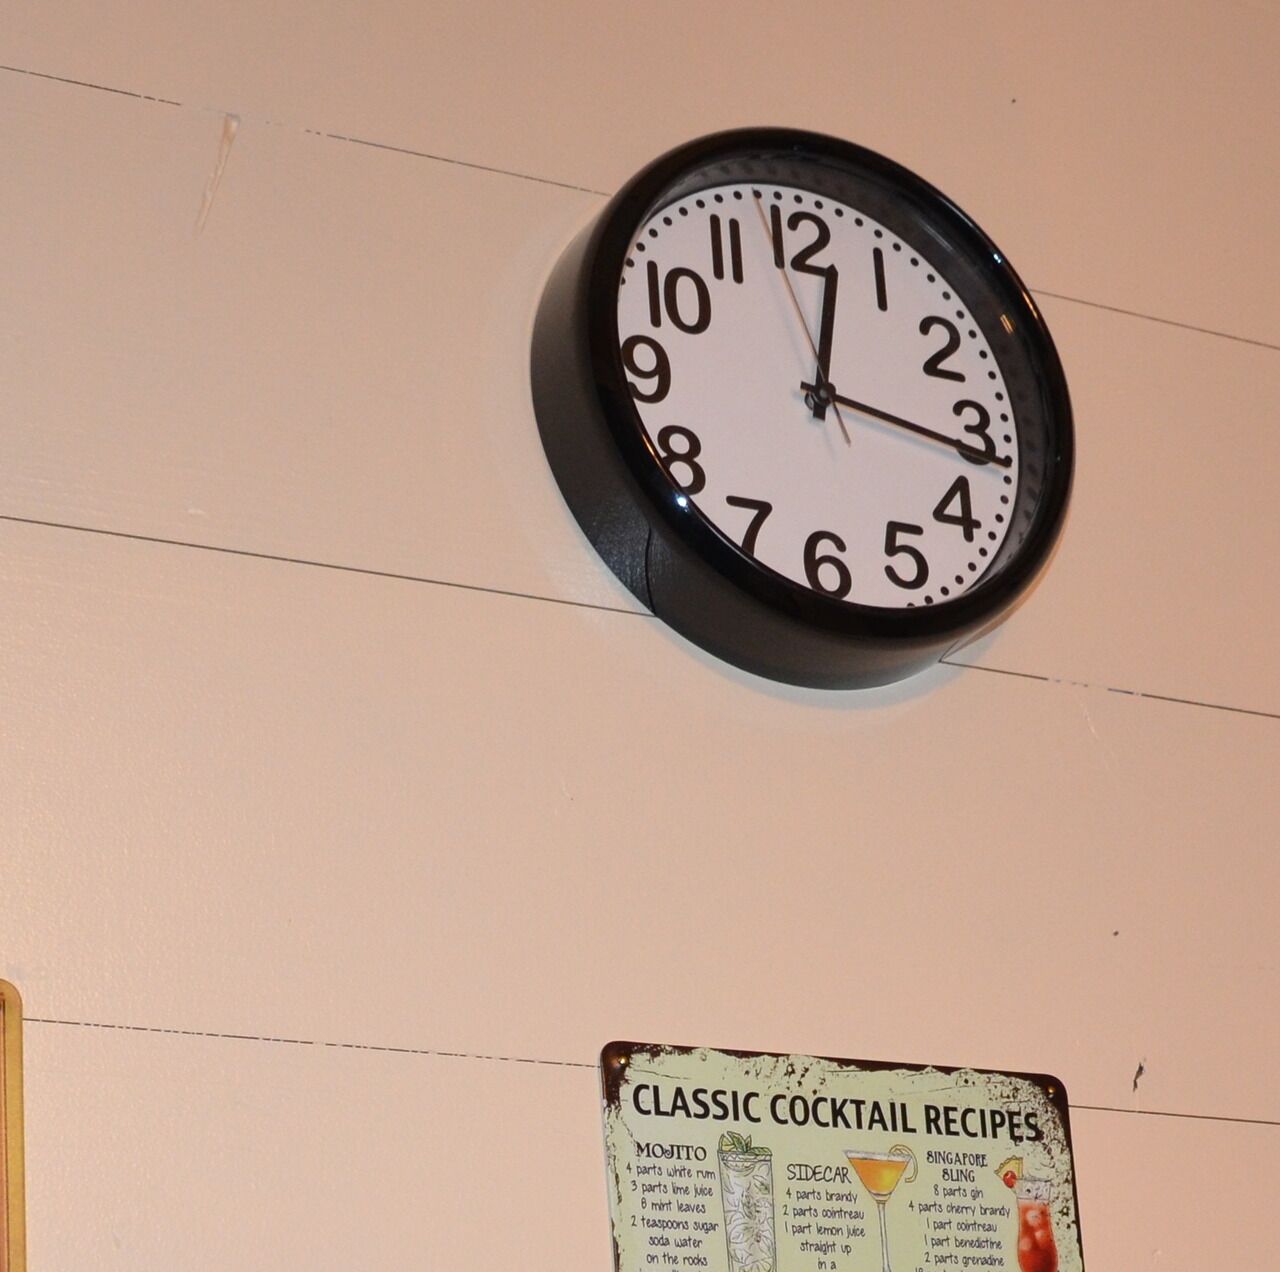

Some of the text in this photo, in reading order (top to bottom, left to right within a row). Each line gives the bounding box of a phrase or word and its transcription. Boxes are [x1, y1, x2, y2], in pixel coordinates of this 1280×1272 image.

[770, 204, 831, 277] 12
[647, 260, 711, 334] 10
[873, 247, 888, 312] 1
[620, 334, 671, 404] 9
[920, 316, 966, 382] 2
[657, 425, 706, 496] 8
[952, 399, 997, 466] 3
[726, 496, 773, 557] 7
[932, 475, 981, 543] 4
[803, 530, 852, 600] 6
[884, 520, 929, 589] 5
[632, 1083, 1043, 1144] CLASSIC COCKTAIL RECIPES
[626, 1162, 716, 1180] 4 parts white rum
[636, 1142, 707, 1161] MOJITO
[786, 1163, 852, 1184] SIDECAR
[926, 1150, 988, 1167] SINGAPORE
[942, 1168, 975, 1183] SLING
[631, 1215, 719, 1235] 2 teaspoons sugar
[908, 1200, 1010, 1218] 4 parts cherry brandy
[648, 1235, 703, 1248] soda water
